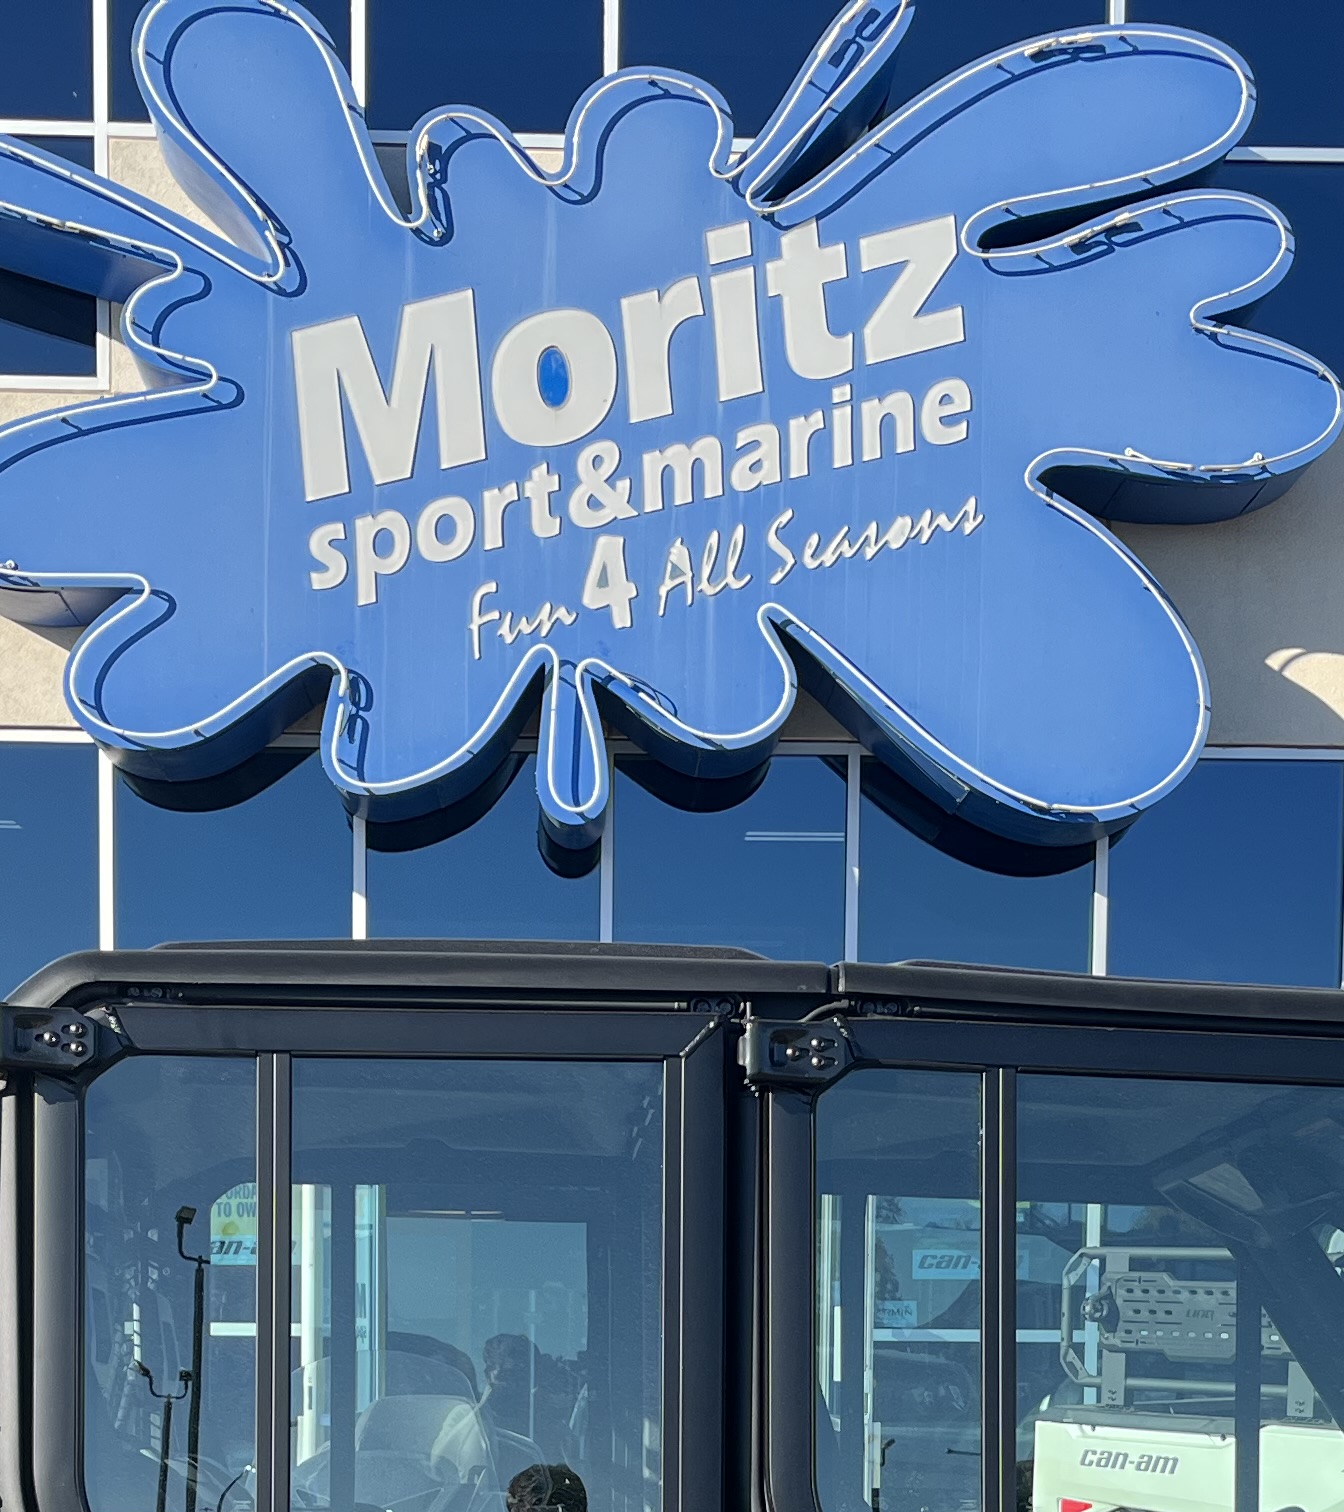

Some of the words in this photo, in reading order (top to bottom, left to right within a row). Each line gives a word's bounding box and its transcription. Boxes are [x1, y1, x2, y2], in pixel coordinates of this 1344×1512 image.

[290, 214, 967, 503] Moritz
[308, 377, 972, 607] sport&marine
[468, 580, 578, 660] Fun
[582, 534, 637, 630] 4
[658, 523, 752, 617] All
[767, 496, 985, 585] Seasons
[216, 1202, 232, 1218] TO
[1079, 1448, 1180, 1475] can-am
